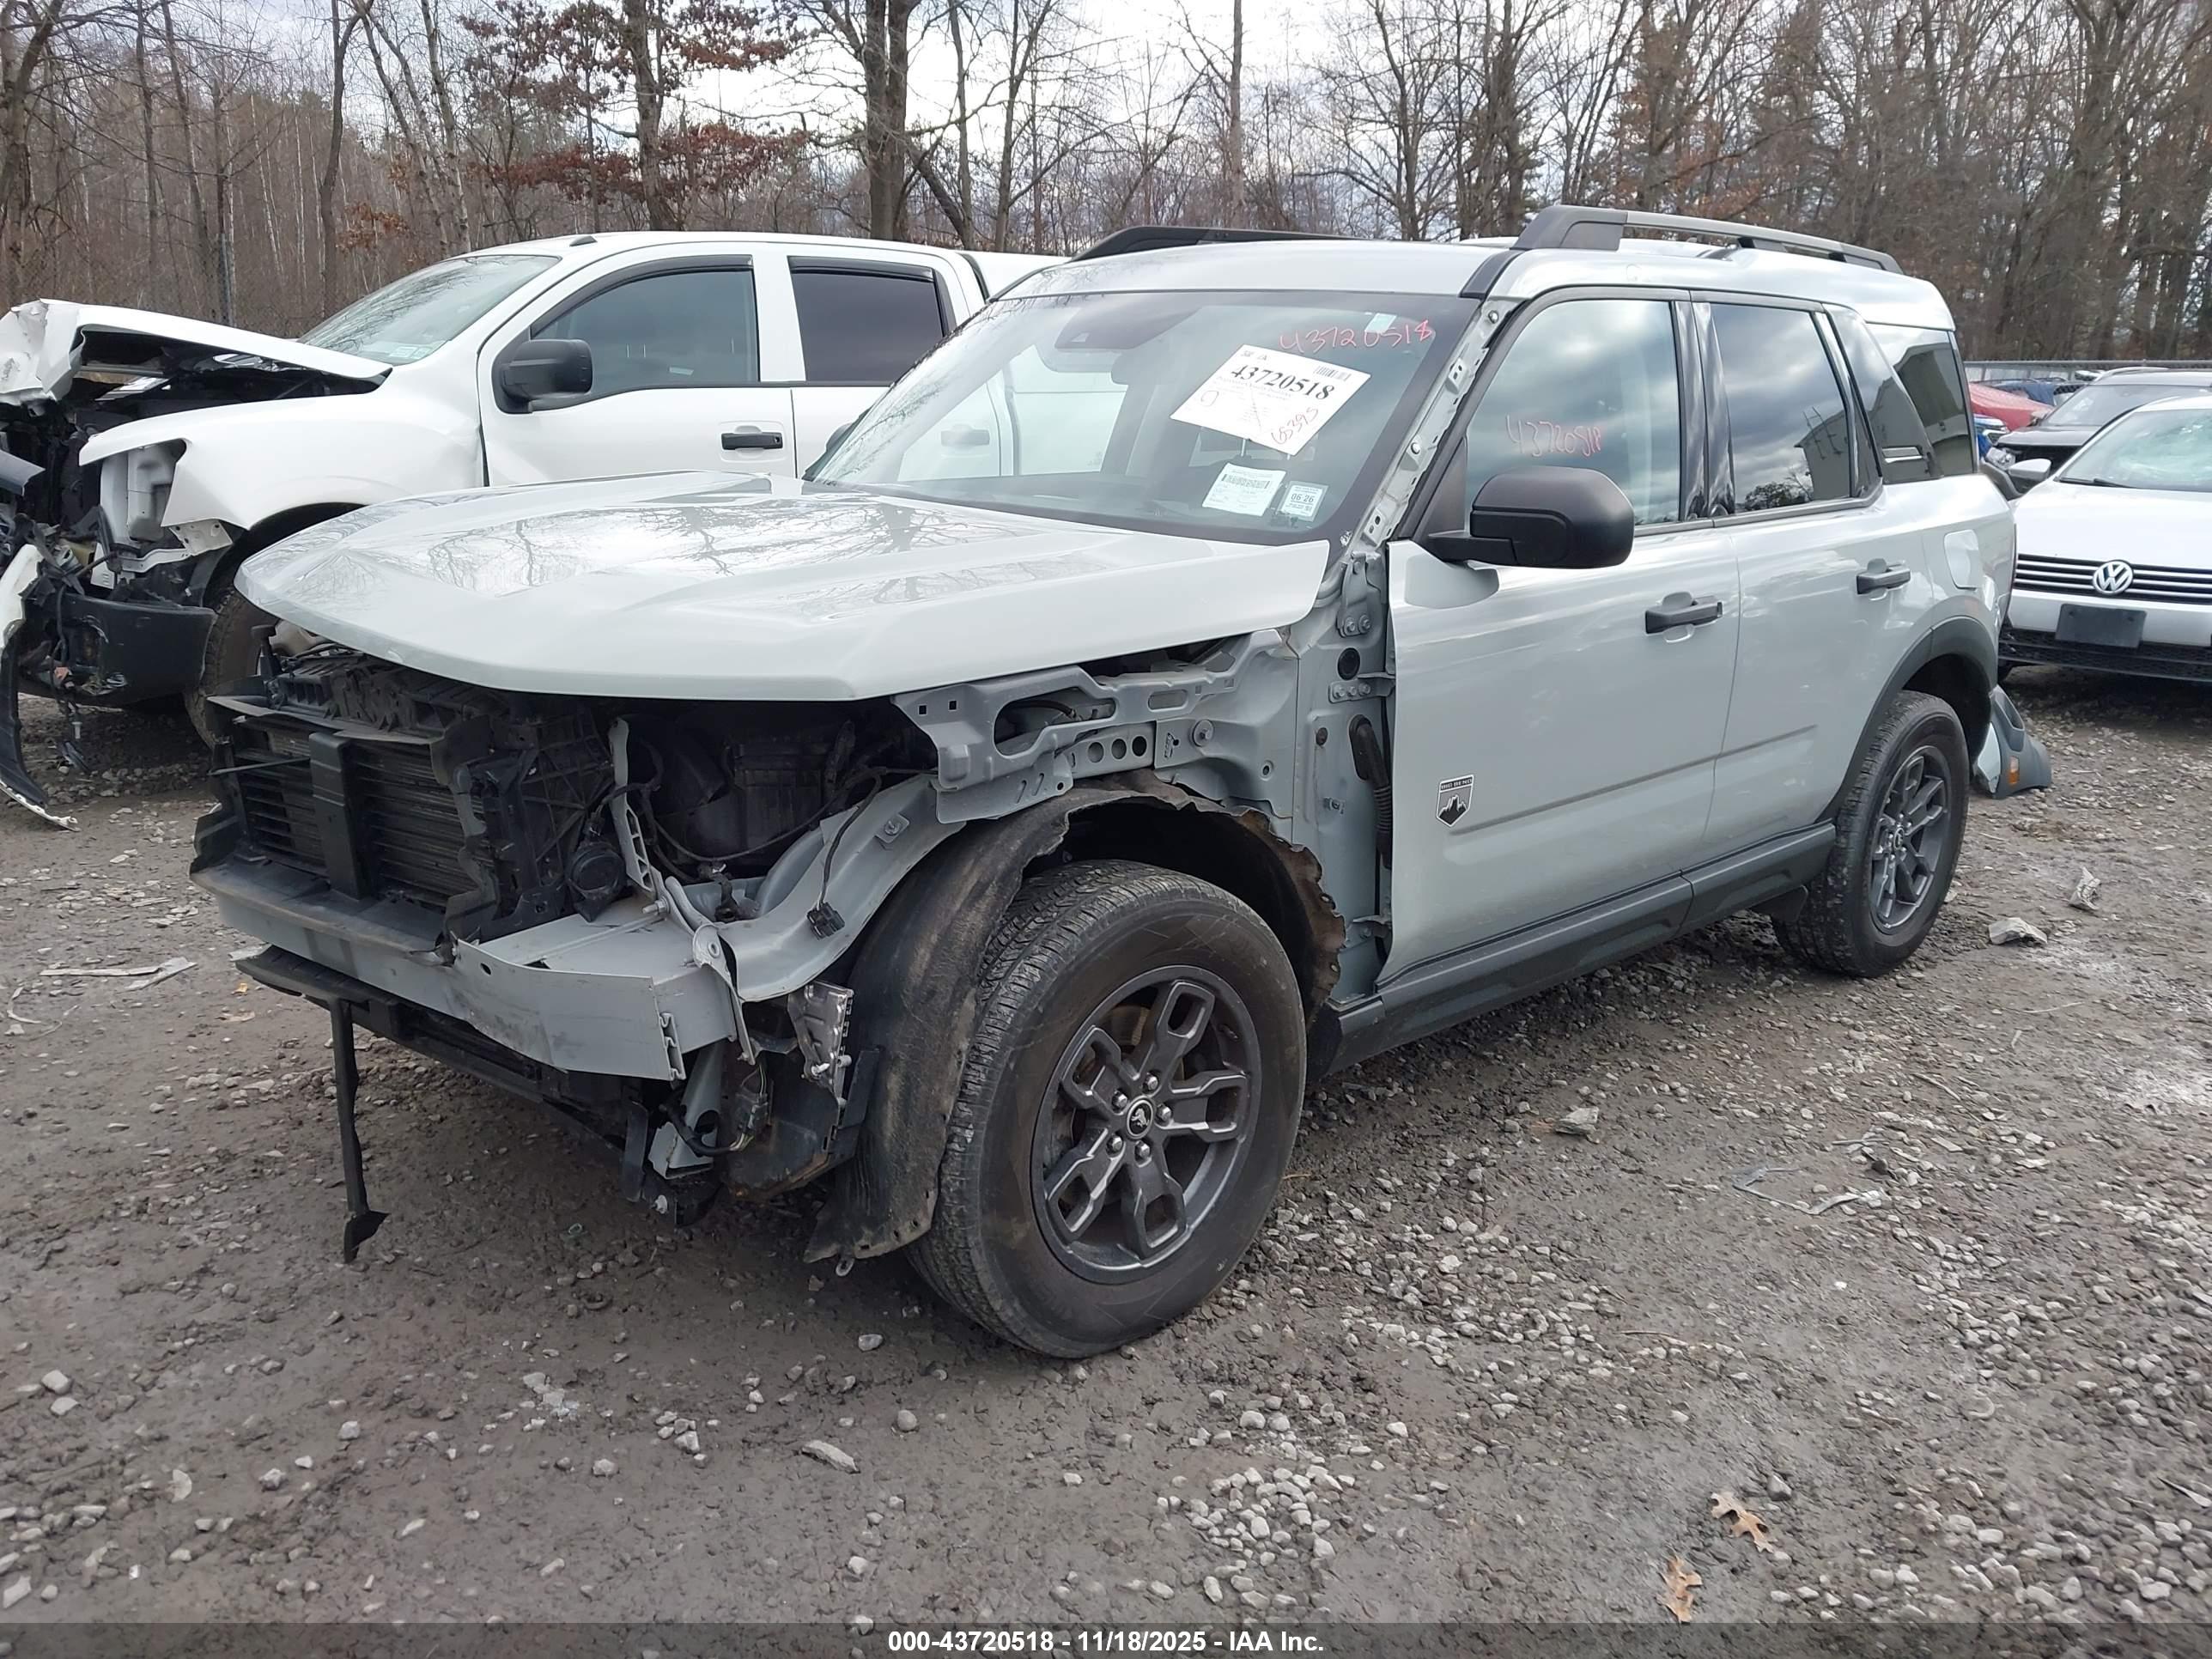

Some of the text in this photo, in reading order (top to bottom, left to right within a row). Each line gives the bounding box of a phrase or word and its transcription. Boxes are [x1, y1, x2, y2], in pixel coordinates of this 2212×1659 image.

[1279, 319, 1433, 354] 43720518
[1231, 364, 1335, 400] 43720518
[1505, 414, 1601, 457] 43720518
